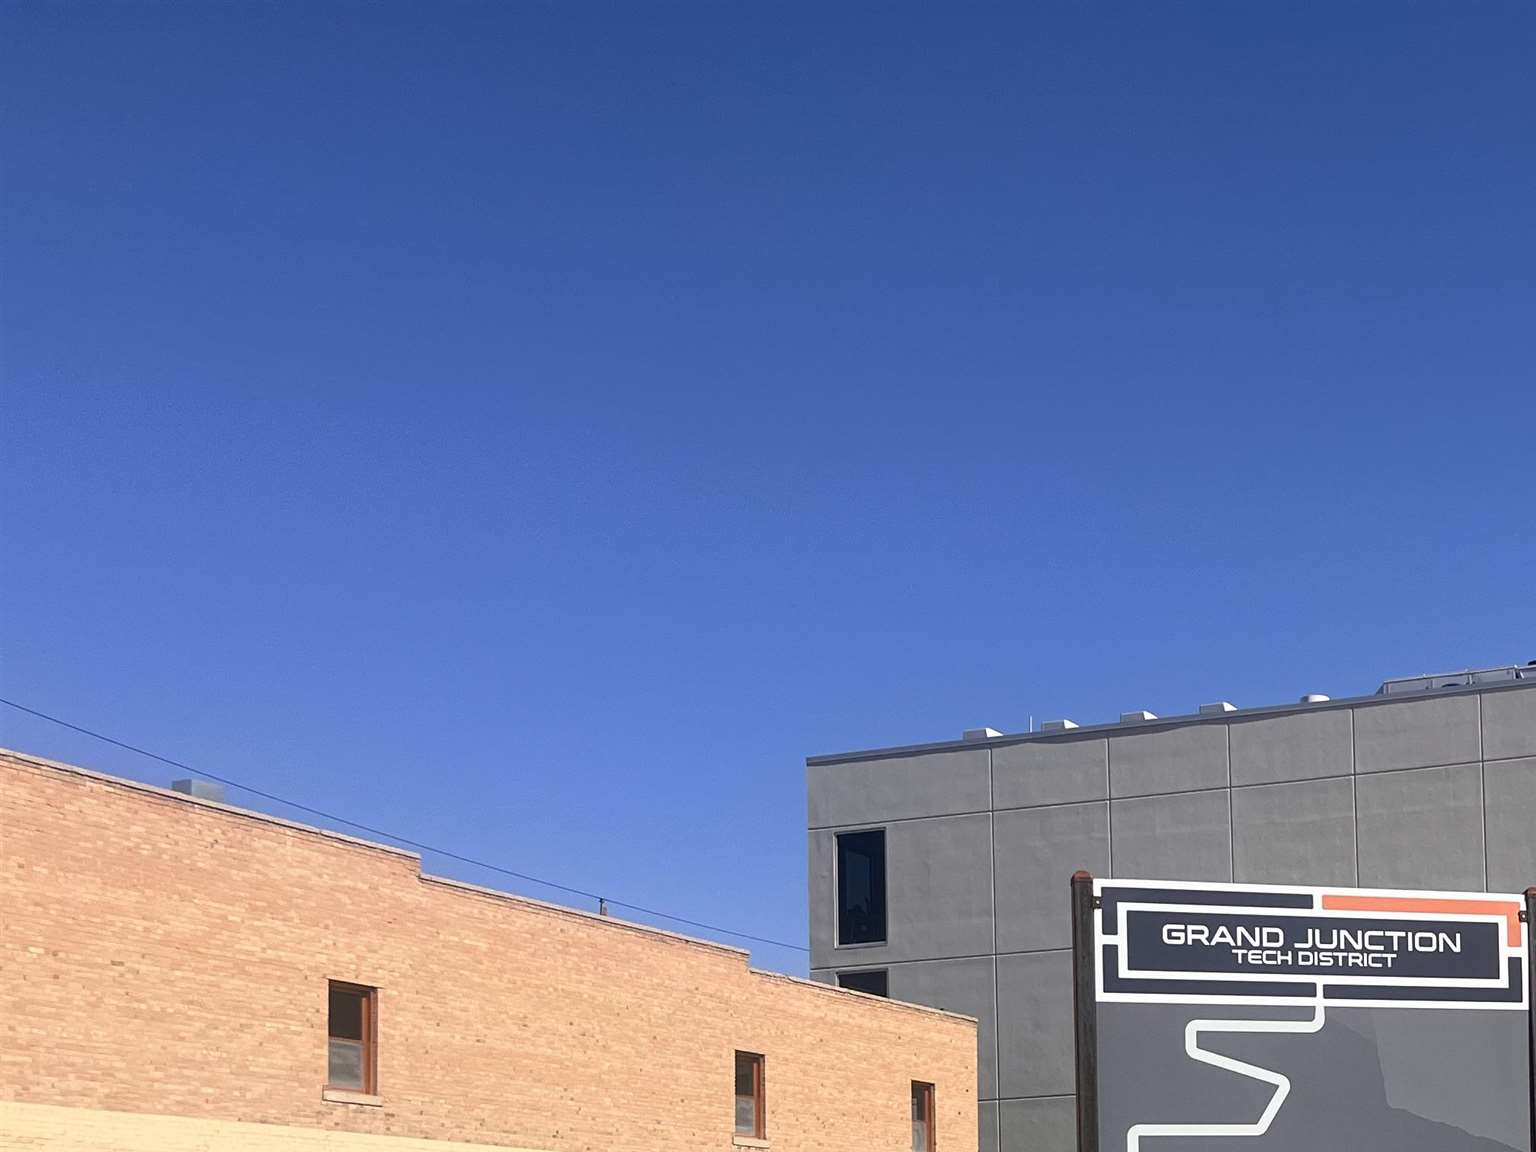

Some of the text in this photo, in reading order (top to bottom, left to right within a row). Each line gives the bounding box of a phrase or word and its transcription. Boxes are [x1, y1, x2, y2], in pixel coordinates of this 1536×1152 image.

[1162, 924, 1461, 953] GRAND JUNCTION
[1232, 949, 1397, 968] TECH DISTRICT
